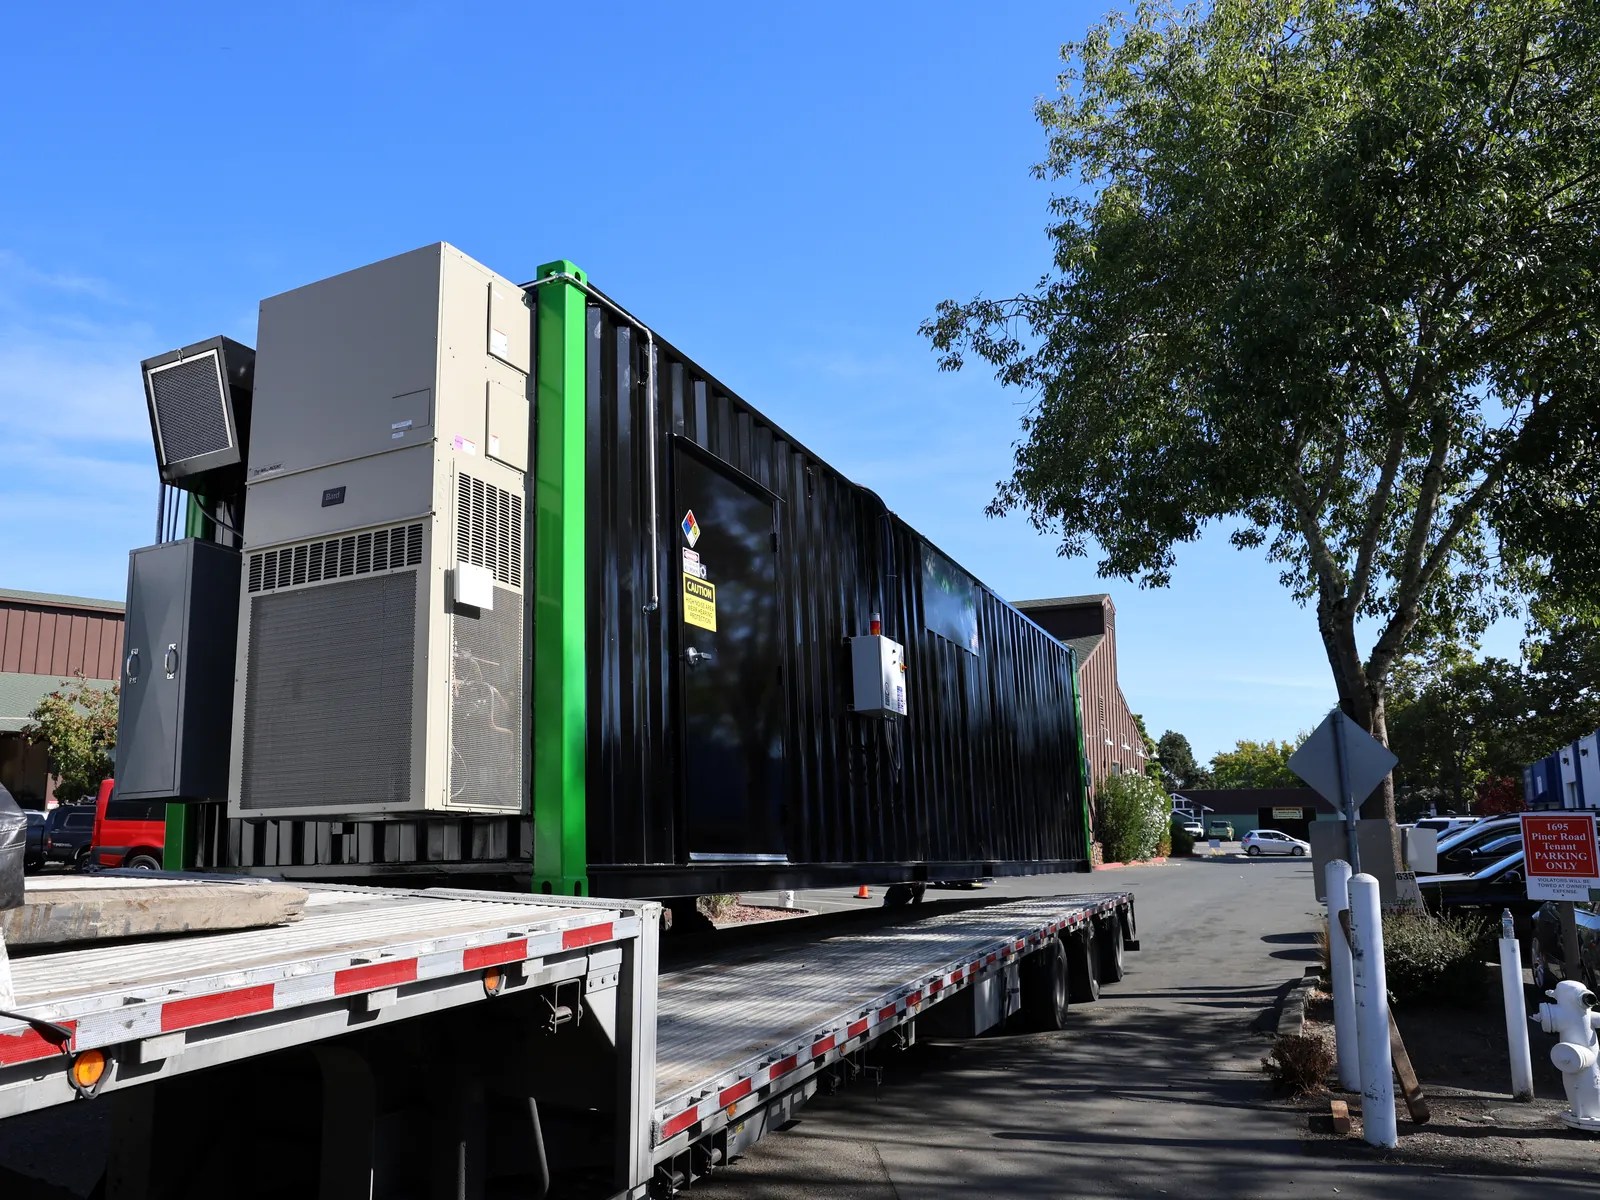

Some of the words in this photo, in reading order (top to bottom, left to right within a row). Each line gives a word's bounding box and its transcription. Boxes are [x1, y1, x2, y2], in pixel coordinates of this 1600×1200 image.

[687, 581, 712, 600] CAUTION
[1547, 823, 1569, 831] 1695
[1531, 832, 1558, 841] Piner
[1560, 832, 1586, 841] Road
[1543, 842, 1577, 850] Tenant
[1535, 852, 1588, 861] PARKING
[1546, 861, 1578, 870] ONLY
